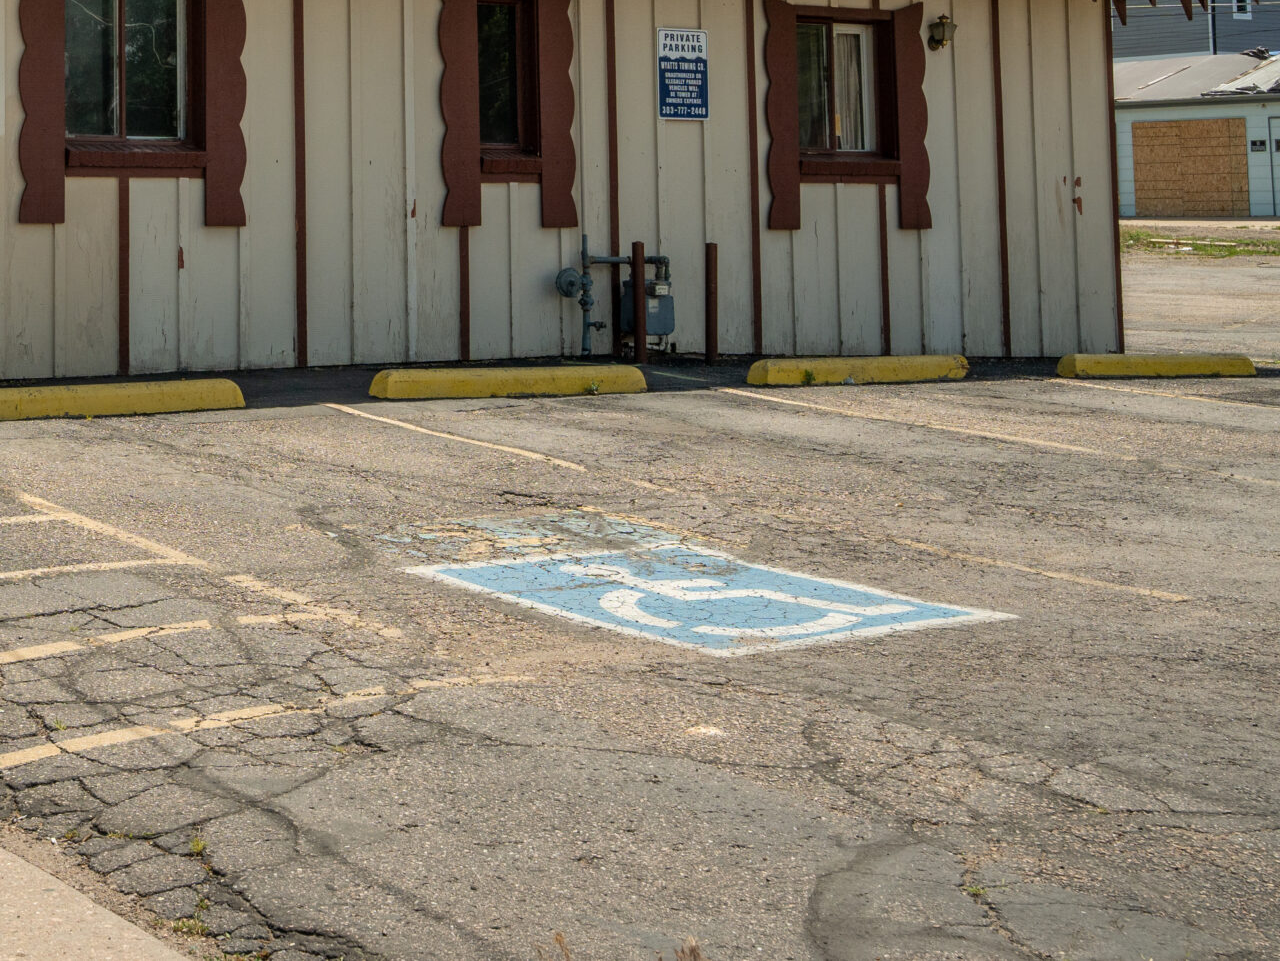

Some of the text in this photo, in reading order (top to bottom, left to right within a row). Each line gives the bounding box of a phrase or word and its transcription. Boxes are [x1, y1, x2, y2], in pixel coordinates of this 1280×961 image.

[664, 32, 701, 43] PRIVATE
[664, 44, 703, 54] PARKING
[660, 62, 678, 70] WYATTS
